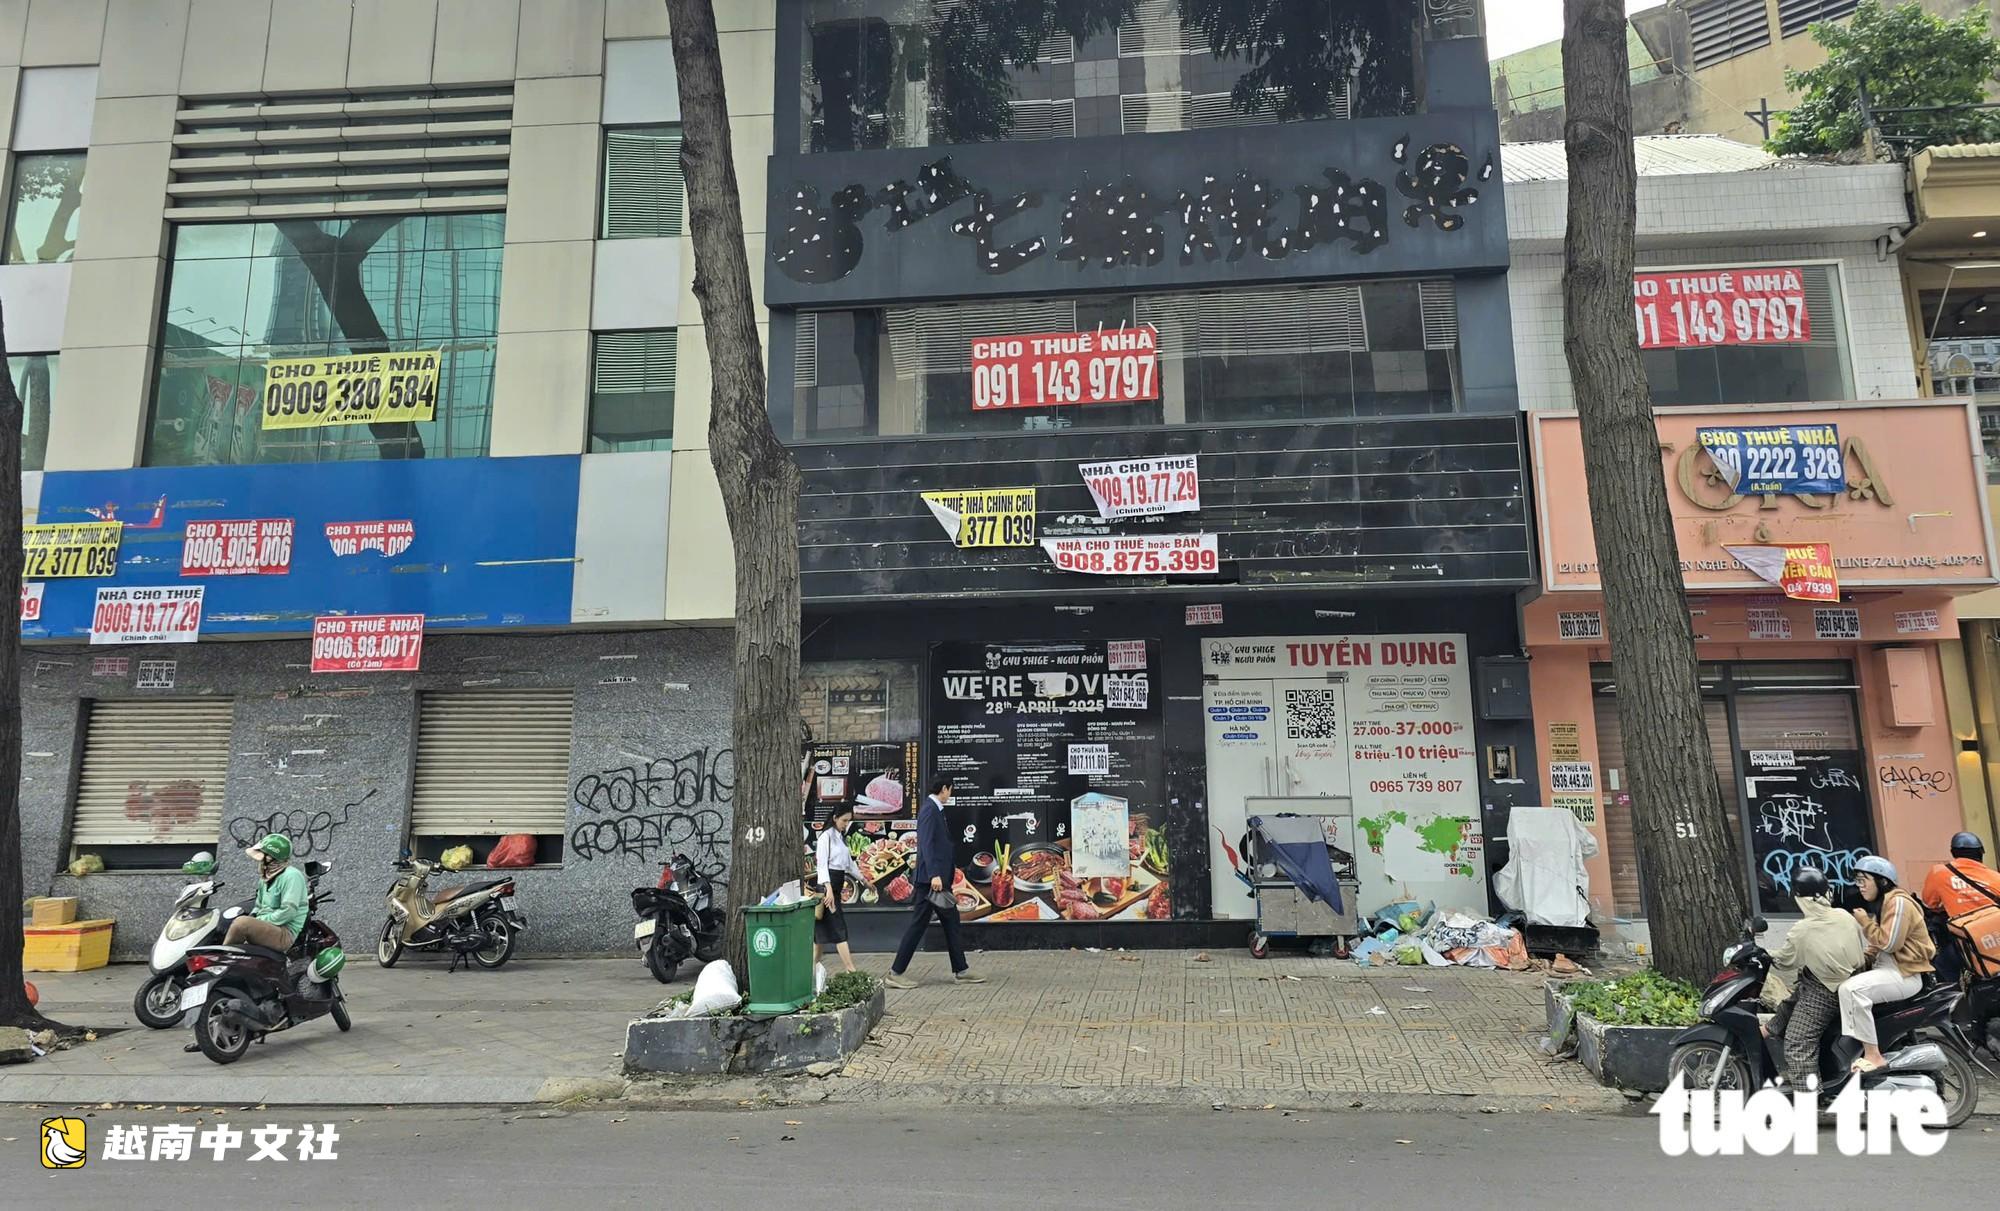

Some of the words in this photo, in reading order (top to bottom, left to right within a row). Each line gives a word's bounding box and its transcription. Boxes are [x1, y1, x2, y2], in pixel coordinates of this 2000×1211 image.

[1667, 273, 1734, 294] THUÊ
[1743, 270, 1800, 292] NHÀ
[1671, 299, 1725, 343] 143
[1733, 297, 1803, 341] 9797
[974, 341, 1023, 359] CHO
[1031, 334, 1092, 355] THUÊ
[1102, 330, 1154, 351] NHÀ
[270, 364, 316, 379] CHO
[324, 357, 380, 375] THUÊ
[388, 354, 435, 372] NHÀ
[975, 363, 1019, 407] 091
[1032, 359, 1081, 403] 143
[1089, 355, 1155, 400] 9797
[267, 380, 328, 416] 0909
[335, 377, 381, 412] 380
[388, 375, 433, 409] 584
[1701, 431, 1739, 446] CHO
[1742, 428, 1792, 445] THUÊ
[1798, 426, 1837, 444] NHÀ
[1081, 464, 1113, 476] NHÀ
[1119, 463, 1150, 473] CHO
[1155, 458, 1195, 470] THUÊ
[1748, 448, 1799, 480] 2222
[1804, 447, 1841, 480] 328
[966, 492, 983, 513] NHÀ
[987, 491, 1013, 513] CHÍNH
[1016, 490, 1033, 512] CHỦ
[33, 526, 55, 545] THUÊ
[56, 525, 74, 545] NHÀ
[75, 524, 102, 544] CHÍNH
[186, 524, 215, 538] CHO
[220, 520, 258, 537] THUÊ
[261, 520, 292, 536] NHÀ
[326, 526, 351, 536] CHO
[354, 523, 384, 534] THUÊ
[387, 521, 413, 533] NHÀ
[967, 516, 997, 545] 377
[1003, 514, 1033, 544] 039
[183, 536, 291, 568] 0906.905.006
[1057, 539, 1082, 551] NHÀ
[1086, 540, 1110, 550] CHO
[1114, 539, 1144, 549] THUÊ
[1174, 536, 1200, 548] BÁN
[1786, 545, 1818, 560] HUÊ
[23, 548, 48, 575] 72
[51, 547, 83, 575] 377
[86, 547, 116, 575] 039
[99, 589, 127, 600] NHÀ
[133, 590, 161, 600] CHO
[167, 588, 202, 599] THUÊ
[1805, 582, 1832, 593] 7939
[94, 601, 200, 633] 0909.19.77.29
[317, 621, 345, 633] CHO
[351, 618, 385, 633] THUÊ
[390, 617, 420, 631] NHÀ
[1816, 617, 1834, 632] 0931
[1834, 617, 1846, 631] 642
[1847, 617, 1859, 631] 166
[315, 635, 419, 659] 0906.98.0017
[1235, 646, 1250, 654] GYU
[1252, 645, 1275, 653] SHIGE
[1286, 636, 1371, 666] TUYỂN
[1381, 642, 1457, 667] DỤNG
[1003, 656, 1020, 666] GYU
[1022, 655, 1049, 665] SHIGE
[943, 676, 1022, 697] WE'RE
[1109, 687, 1122, 701] 0931
[1124, 688, 1134, 701] 642
[1136, 688, 1146, 701] 166
[986, 701, 1012, 715] 28th
[1068, 699, 1104, 713] 2025
[1353, 726, 1390, 736] 27.000
[1396, 722, 1452, 735] 37.000
[1355, 751, 1362, 760] 8
[1364, 750, 1390, 762] triệu
[1395, 746, 1415, 759] 10
[1419, 745, 1458, 763] triệu
[1752, 753, 1764, 761] CHO
[1765, 752, 1780, 761] THUÊ
[1781, 752, 1792, 760] NHÀ
[1564, 764, 1578, 772] THUÊ
[1370, 780, 1404, 793] 0965
[1408, 780, 1433, 792] 739
[1438, 780, 1462, 792] 807
[745, 826, 765, 843] 49
[1676, 822, 1697, 838] 51
